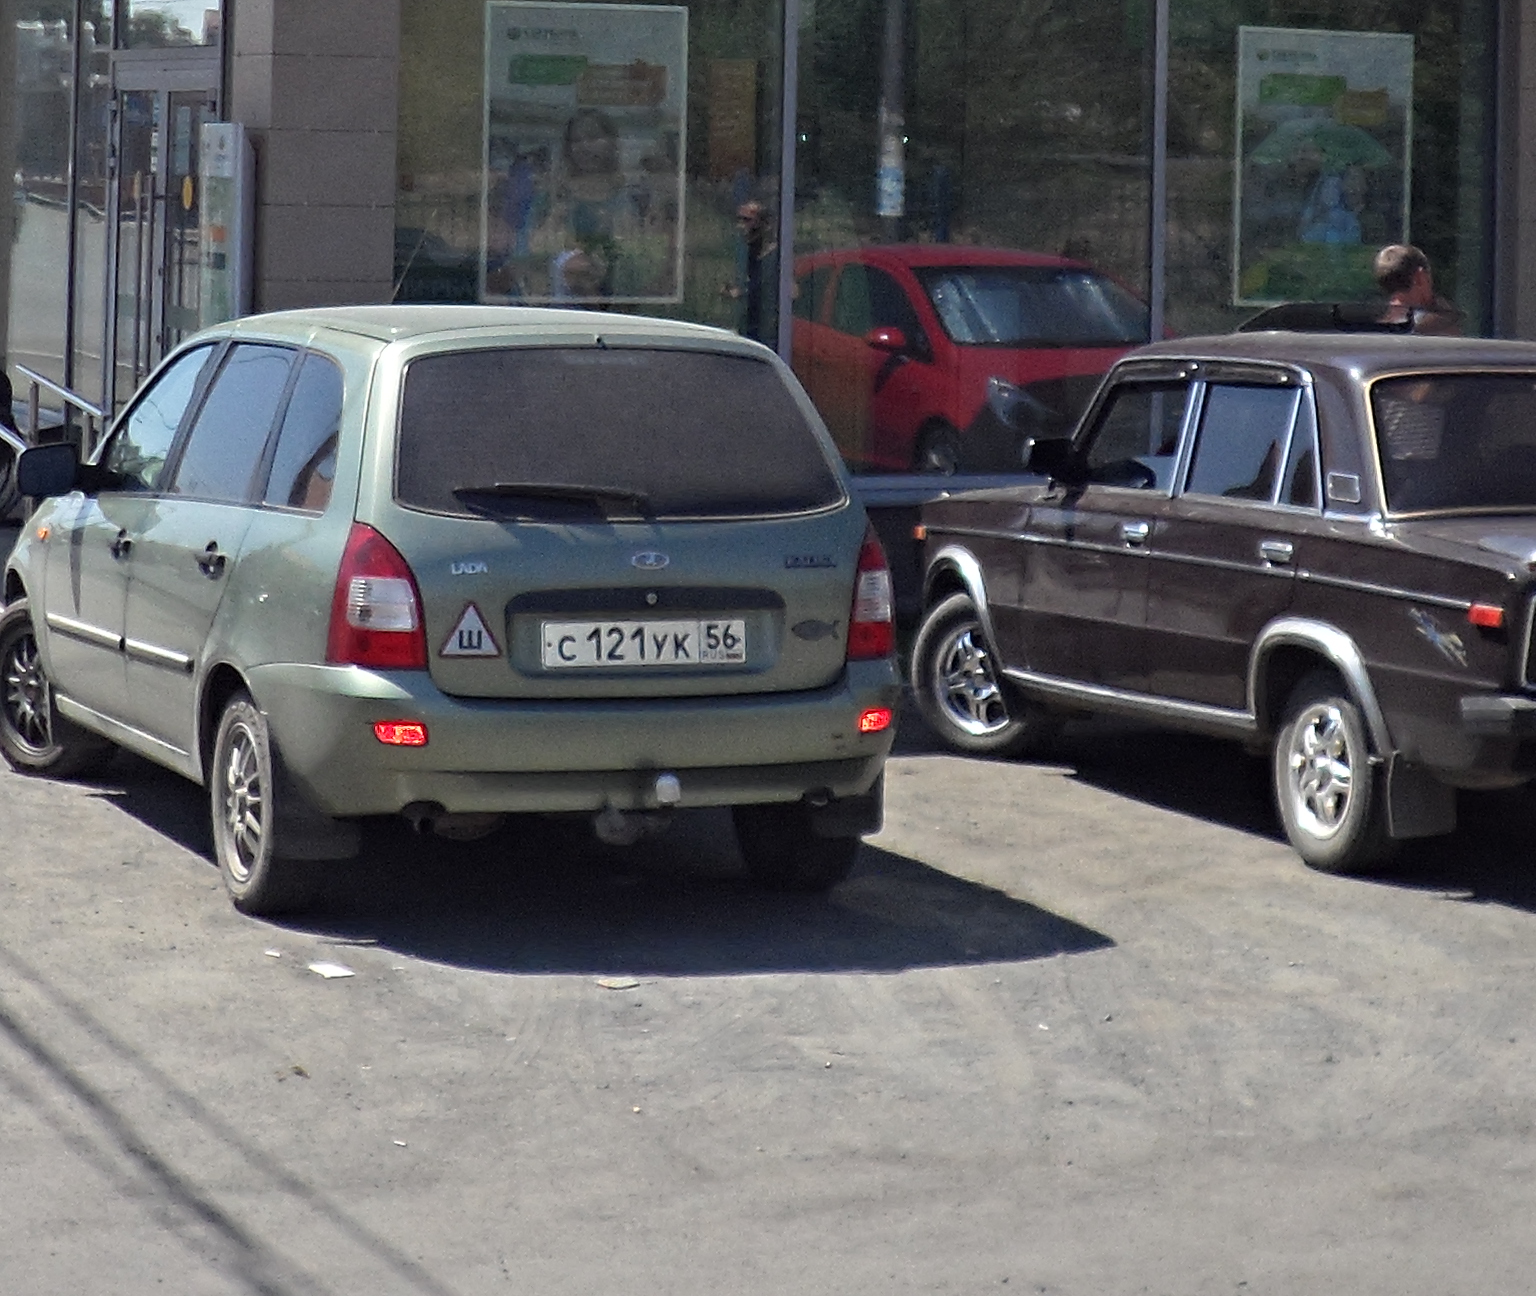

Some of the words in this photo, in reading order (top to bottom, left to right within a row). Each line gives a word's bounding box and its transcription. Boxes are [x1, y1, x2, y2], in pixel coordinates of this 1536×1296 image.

[451, 561, 489, 575] LADA
[458, 629, 482, 650] Ш
[706, 624, 736, 649] 56
